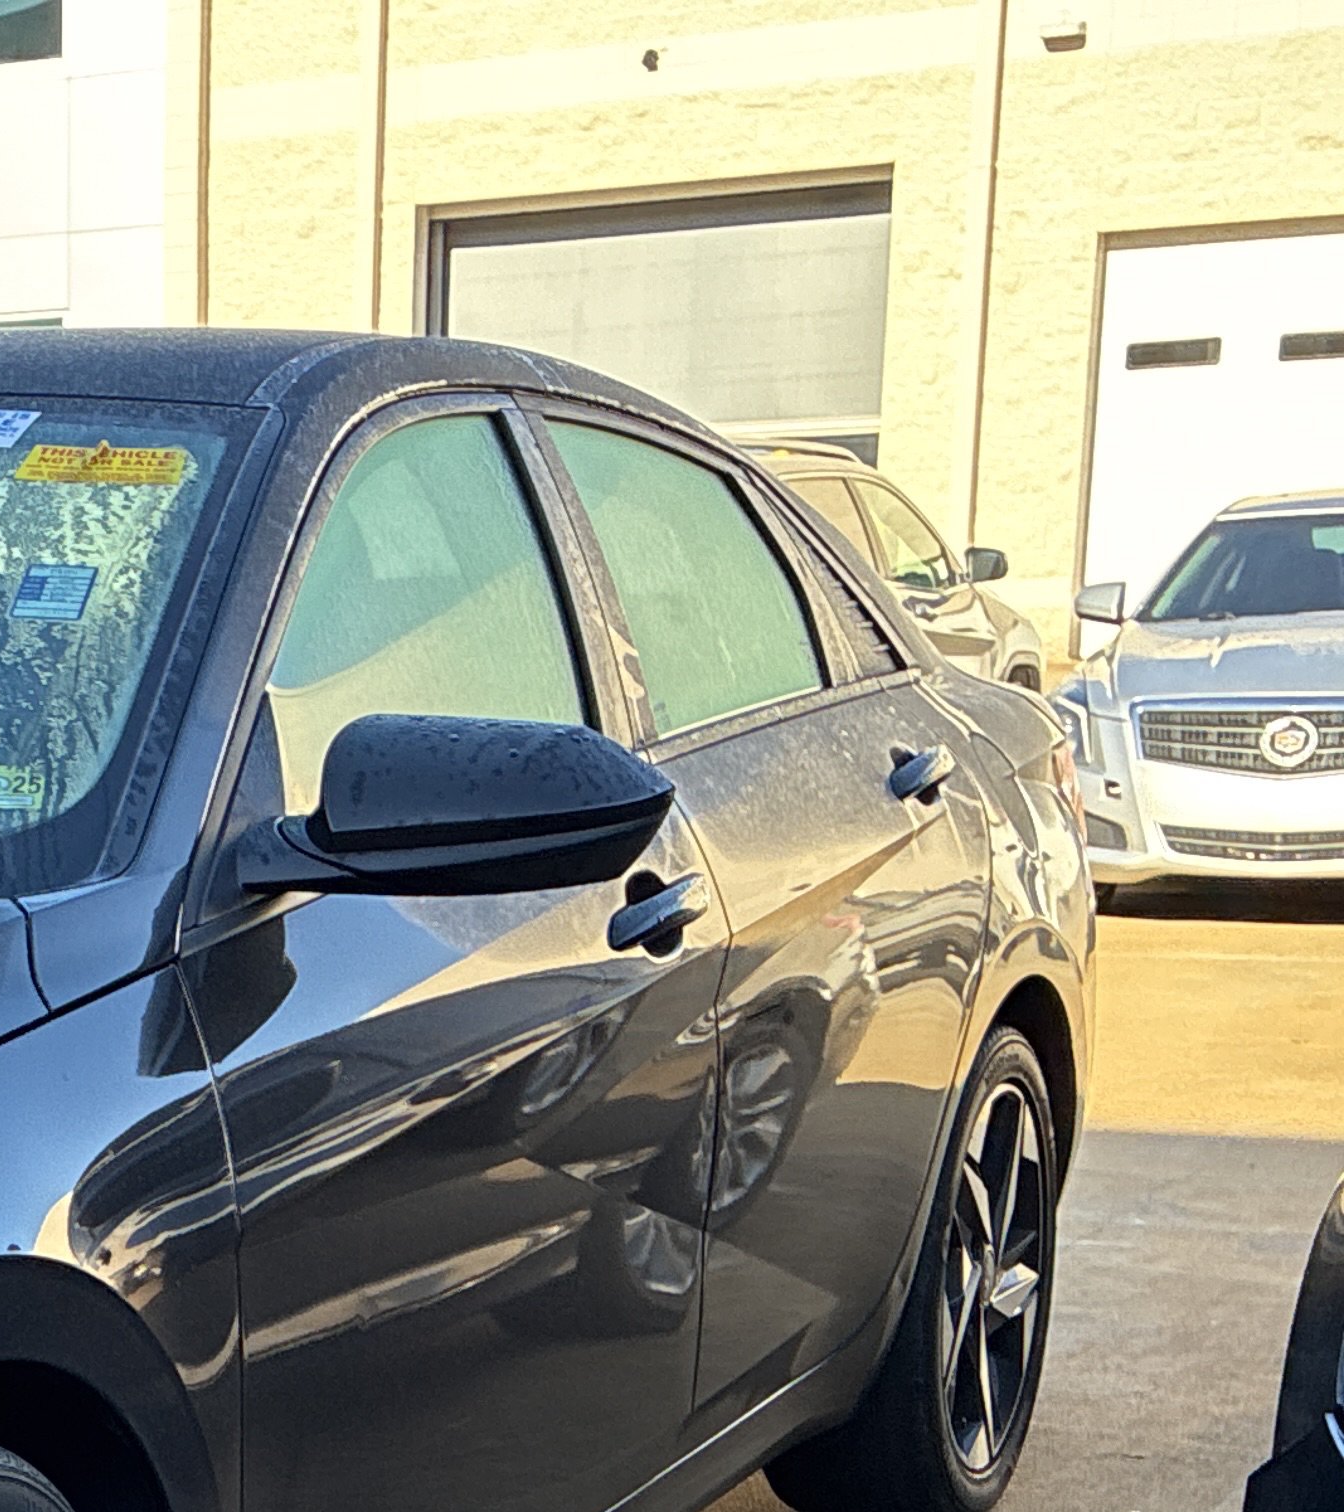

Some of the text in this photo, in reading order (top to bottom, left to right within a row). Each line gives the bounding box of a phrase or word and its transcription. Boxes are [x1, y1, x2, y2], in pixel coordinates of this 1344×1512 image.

[39, 447, 86, 457] THIS
[37, 457, 76, 465] NOT
[120, 458, 171, 467] SALE
[12, 775, 42, 794] 25
